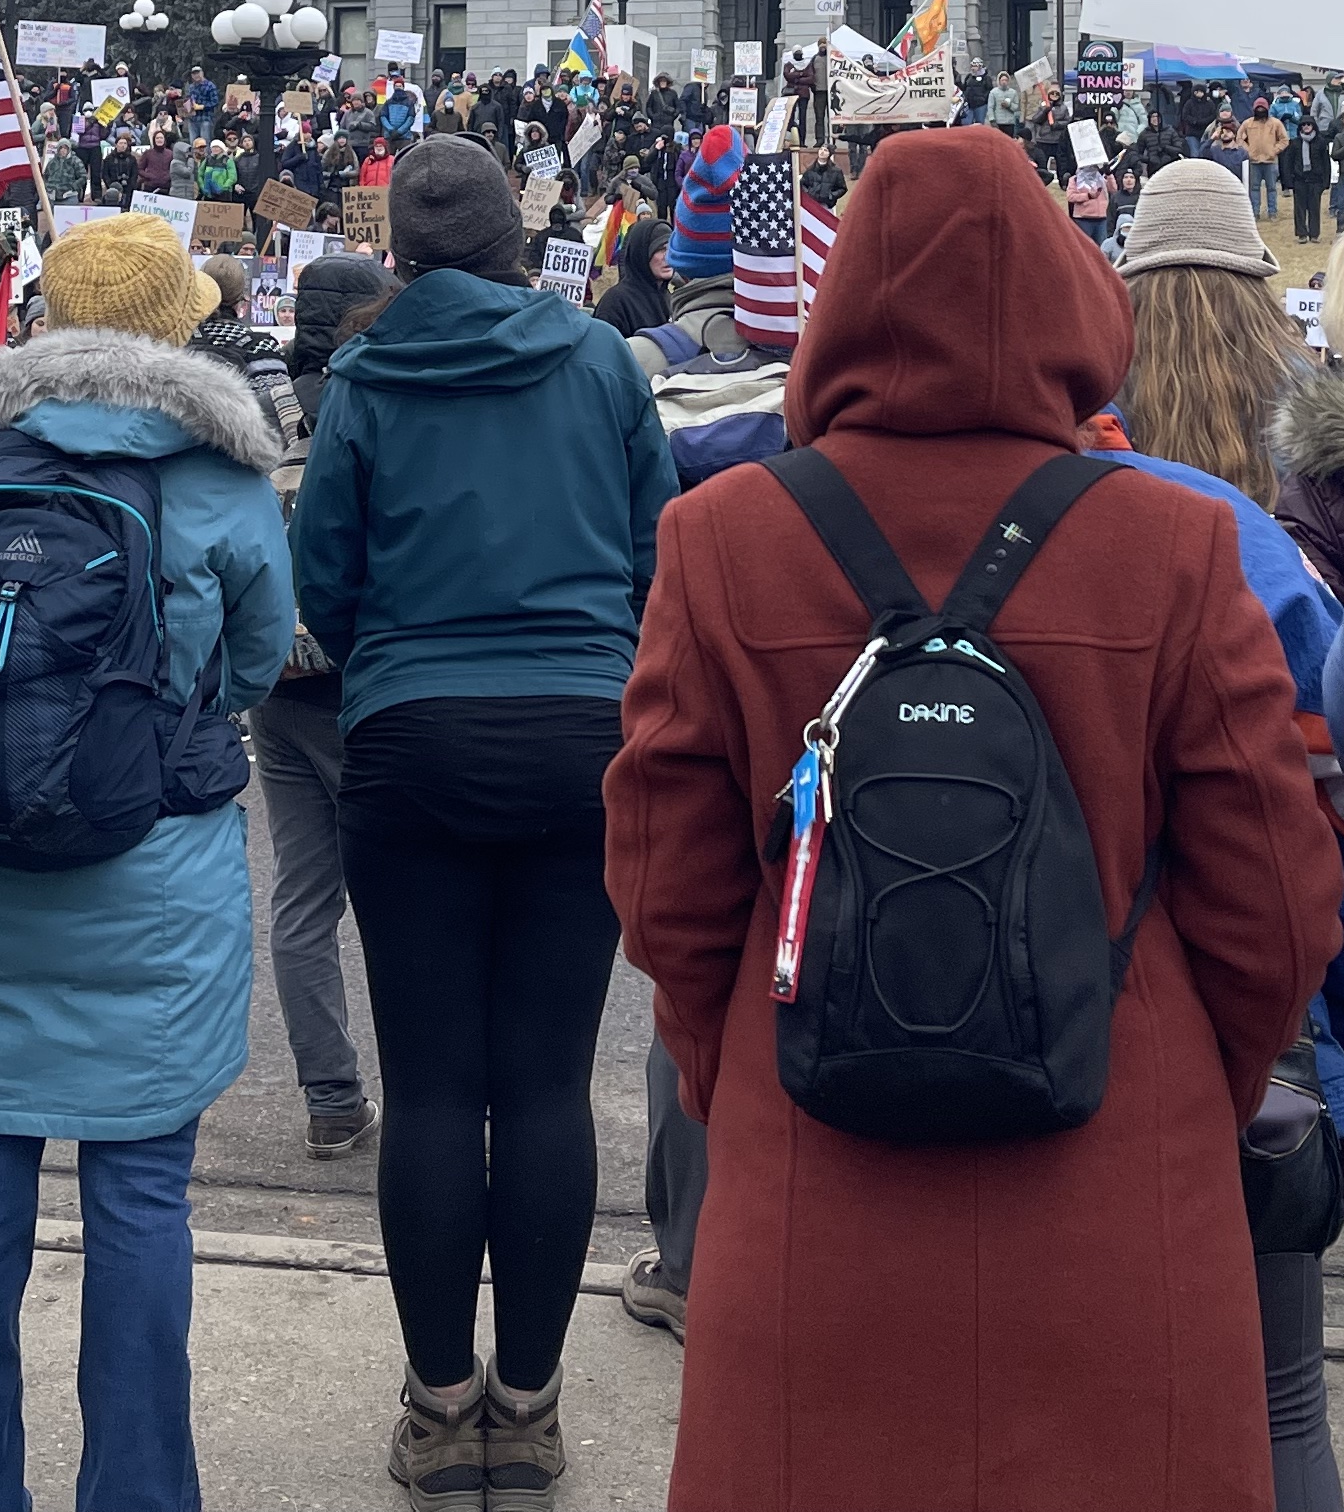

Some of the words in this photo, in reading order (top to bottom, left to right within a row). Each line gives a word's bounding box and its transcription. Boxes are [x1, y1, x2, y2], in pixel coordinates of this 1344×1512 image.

[1077, 60, 1123, 72] PROTECT
[909, 76, 945, 87] NIGHT
[1078, 75, 1122, 88] TRANS
[909, 88, 946, 99] MARE
[525, 146, 556, 164] DEFEND
[529, 177, 556, 192] THEN
[143, 194, 157, 203] THE
[344, 191, 356, 203] No
[203, 203, 232, 214] STOP
[357, 202, 373, 210] KKK
[345, 212, 359, 224] No
[347, 223, 381, 244] USA!
[547, 244, 589, 258] DEFEND
[544, 252, 588, 277] LGBTQ
[257, 295, 276, 310] FUC
[1299, 300, 1323, 312] DEF
